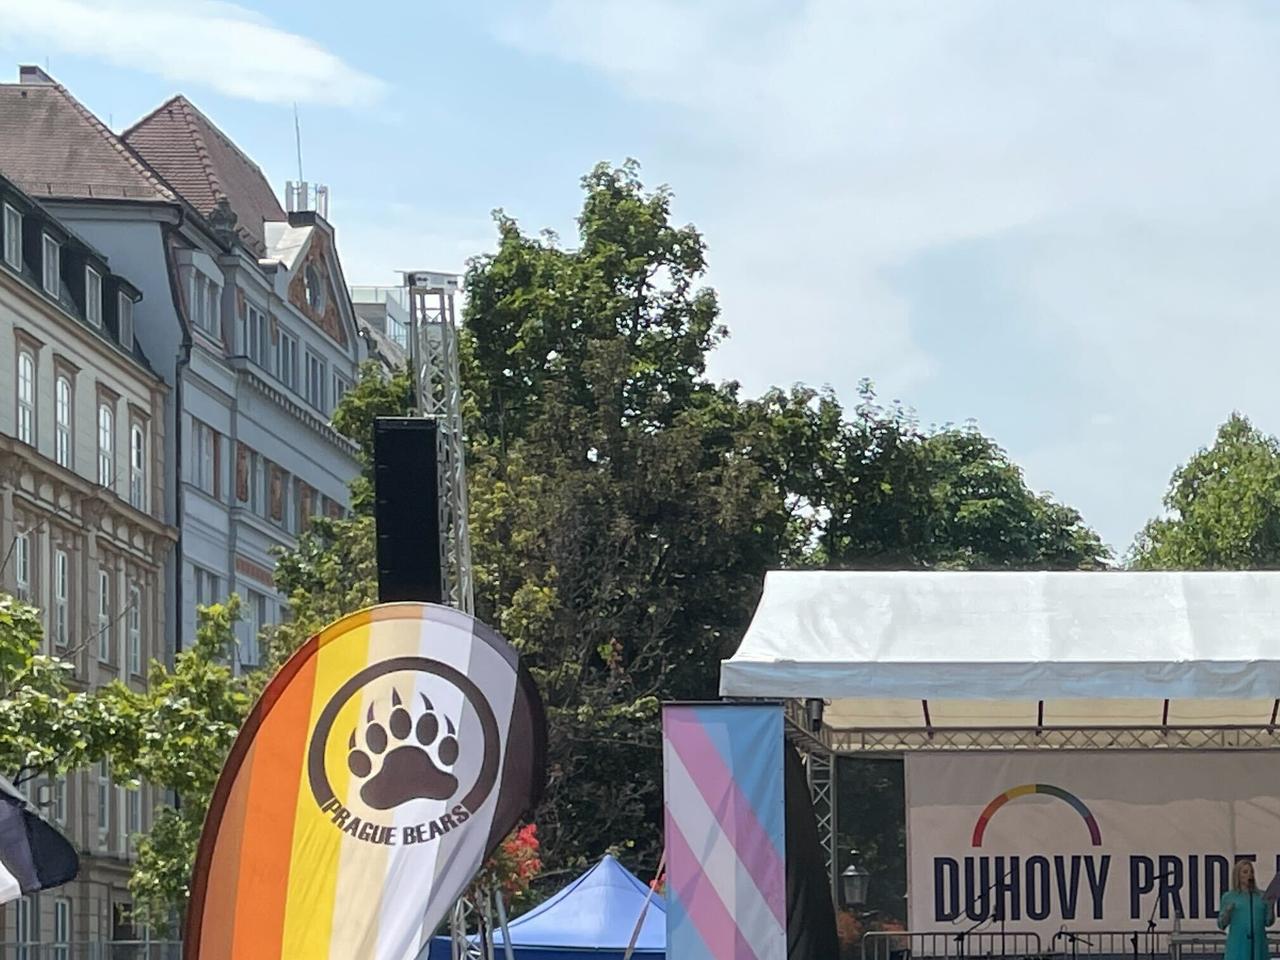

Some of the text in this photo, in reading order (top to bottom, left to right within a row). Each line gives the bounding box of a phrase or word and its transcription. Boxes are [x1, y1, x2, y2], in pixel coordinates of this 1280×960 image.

[322, 799, 470, 846] PRAGUE BEARS
[934, 854, 1111, 922] DUHOVY
[1129, 853, 1257, 920] PRID
